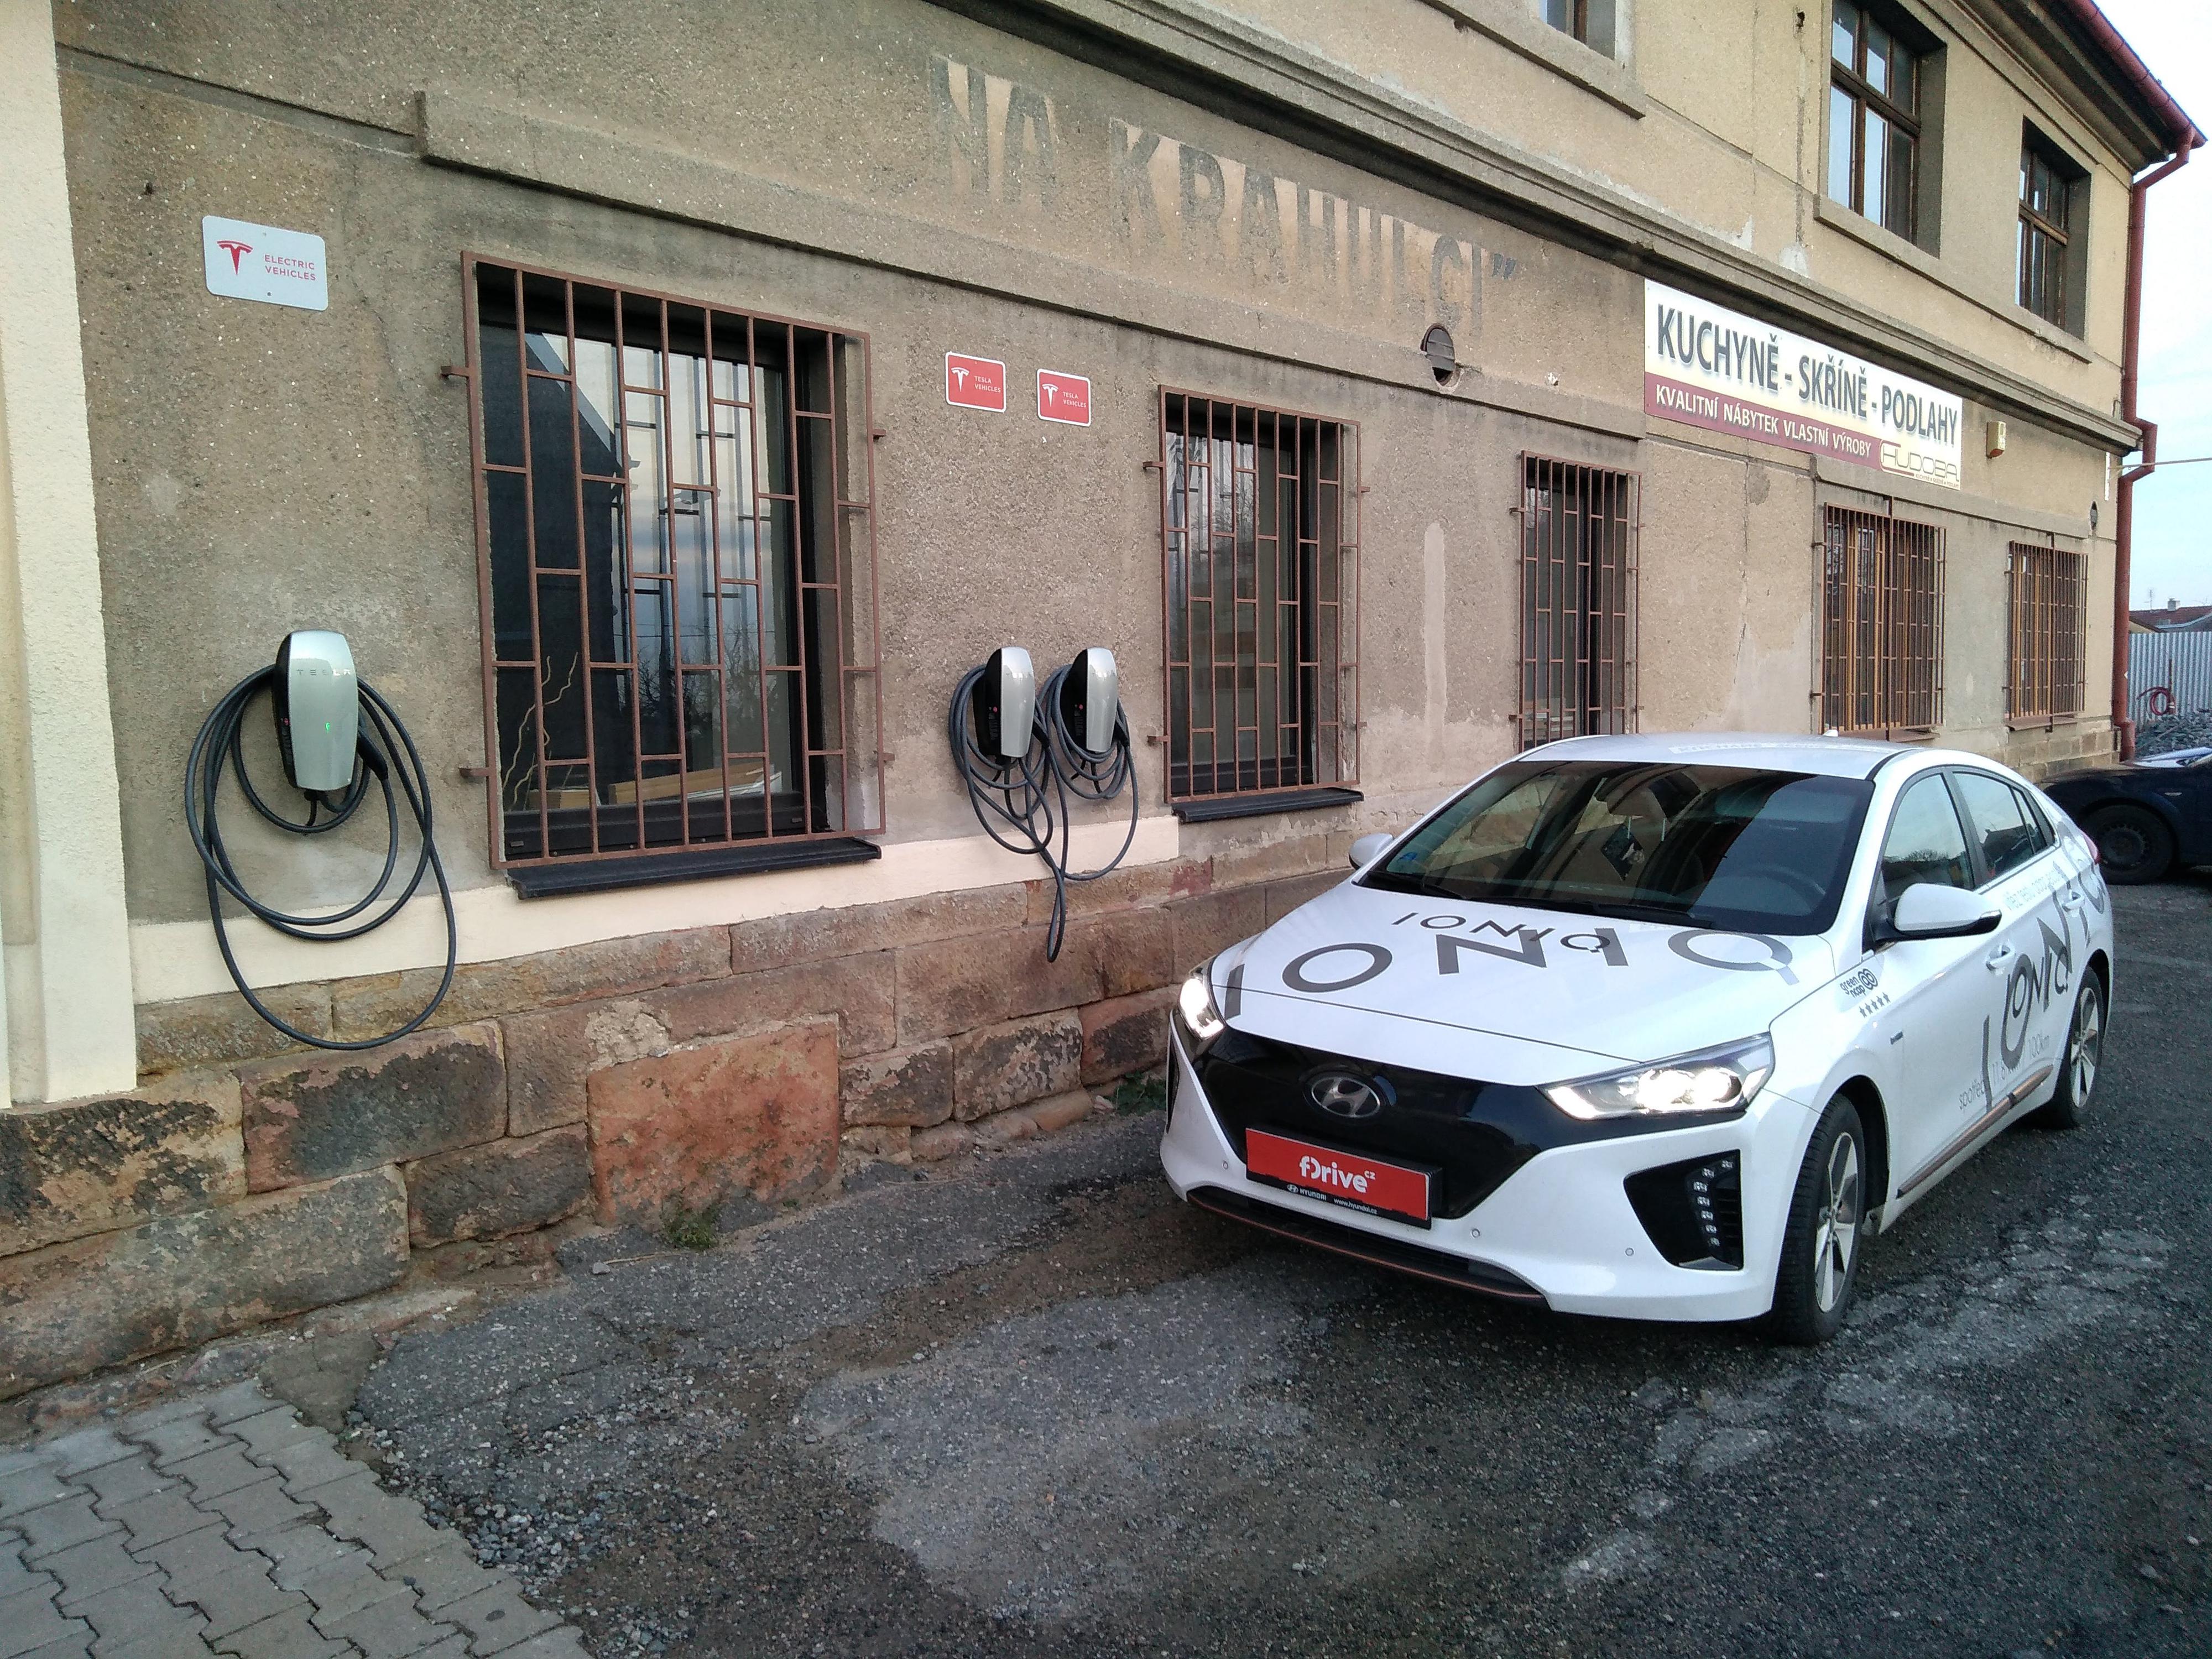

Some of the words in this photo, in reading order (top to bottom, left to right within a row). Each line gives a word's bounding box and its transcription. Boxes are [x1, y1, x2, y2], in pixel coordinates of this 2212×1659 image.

[265, 254, 315, 269] ELECTRIC
[265, 266, 316, 281] VEHICLES
[974, 375, 992, 384] TESLA
[1658, 304, 1778, 391] KUCHYNĚ
[1799, 354, 1867, 418] SKŘÍNĚ
[1882, 385, 1957, 445] PODLAHY
[974, 384, 1001, 393] VEHICLES
[1063, 399, 1087, 408] VEHICLES
[1656, 384, 1719, 419] KVALITNÍ
[1724, 403, 1779, 435] NÁBYTEK
[1783, 419, 1829, 447] VLASTNÍ
[1833, 431, 1872, 457] VÝROBY
[1391, 912, 1610, 954] IONIQ
[1224, 928, 1799, 1019] IONIQ
[1840, 977, 1860, 995] green
[1850, 985, 1866, 998] ncap
[1300, 1188, 1327, 1201] HYUNDAI
[1333, 1198, 1378, 1215] www.hyundai.cz
